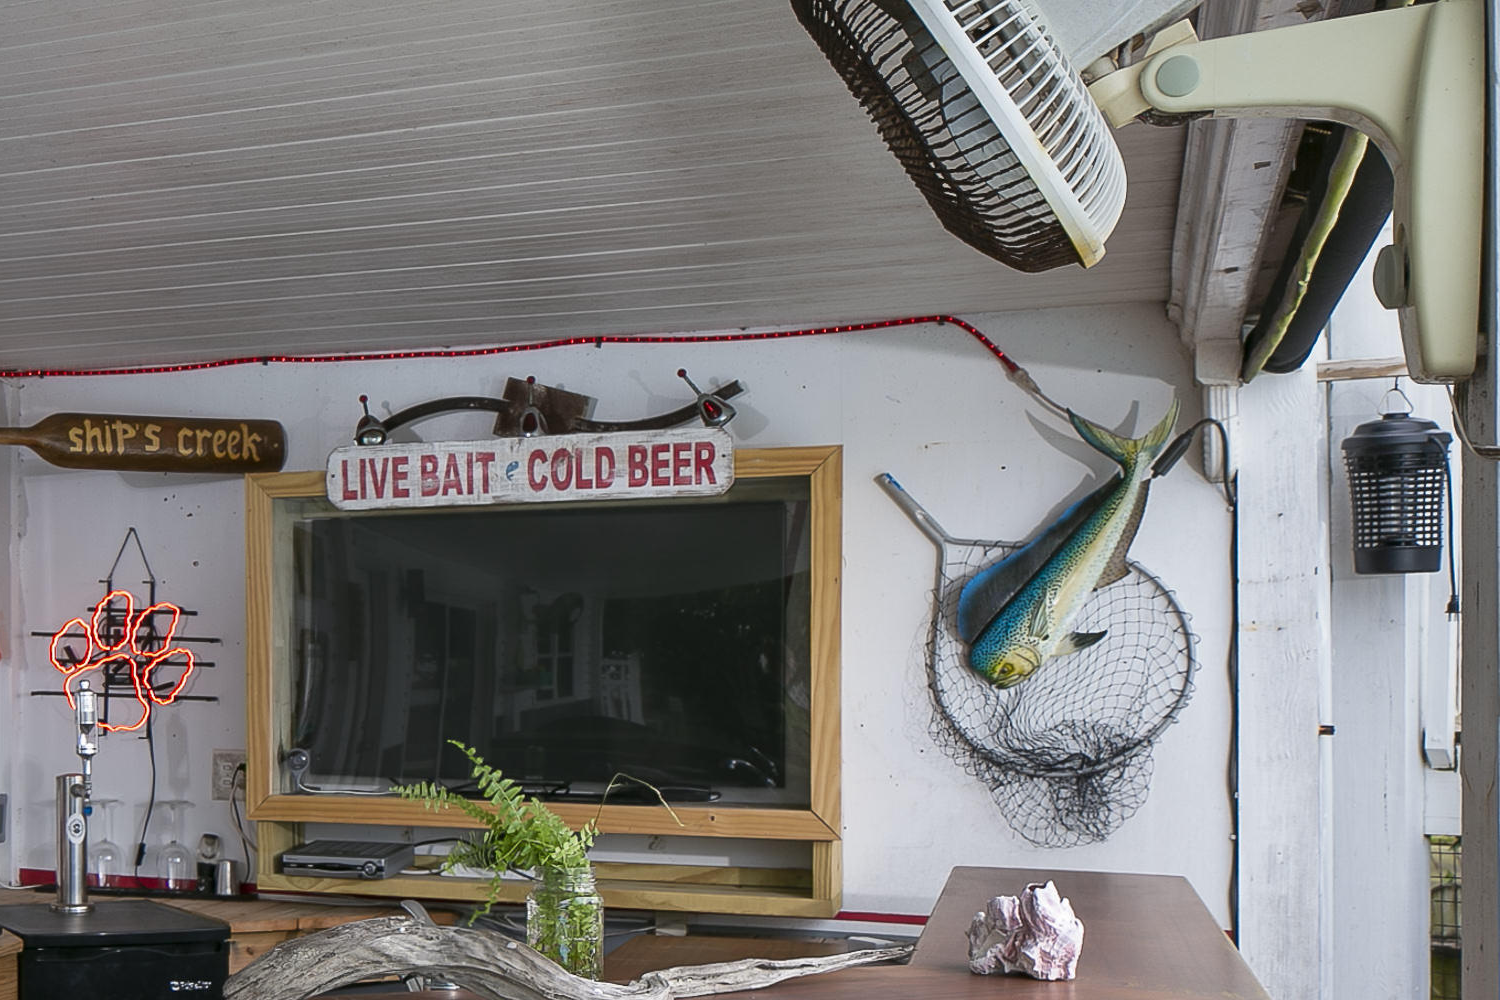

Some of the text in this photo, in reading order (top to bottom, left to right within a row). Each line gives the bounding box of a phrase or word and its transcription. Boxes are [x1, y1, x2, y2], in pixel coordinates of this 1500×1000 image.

[177, 423, 262, 462] creek
[341, 441, 717, 500] LIVE BAIT COLD BEER
